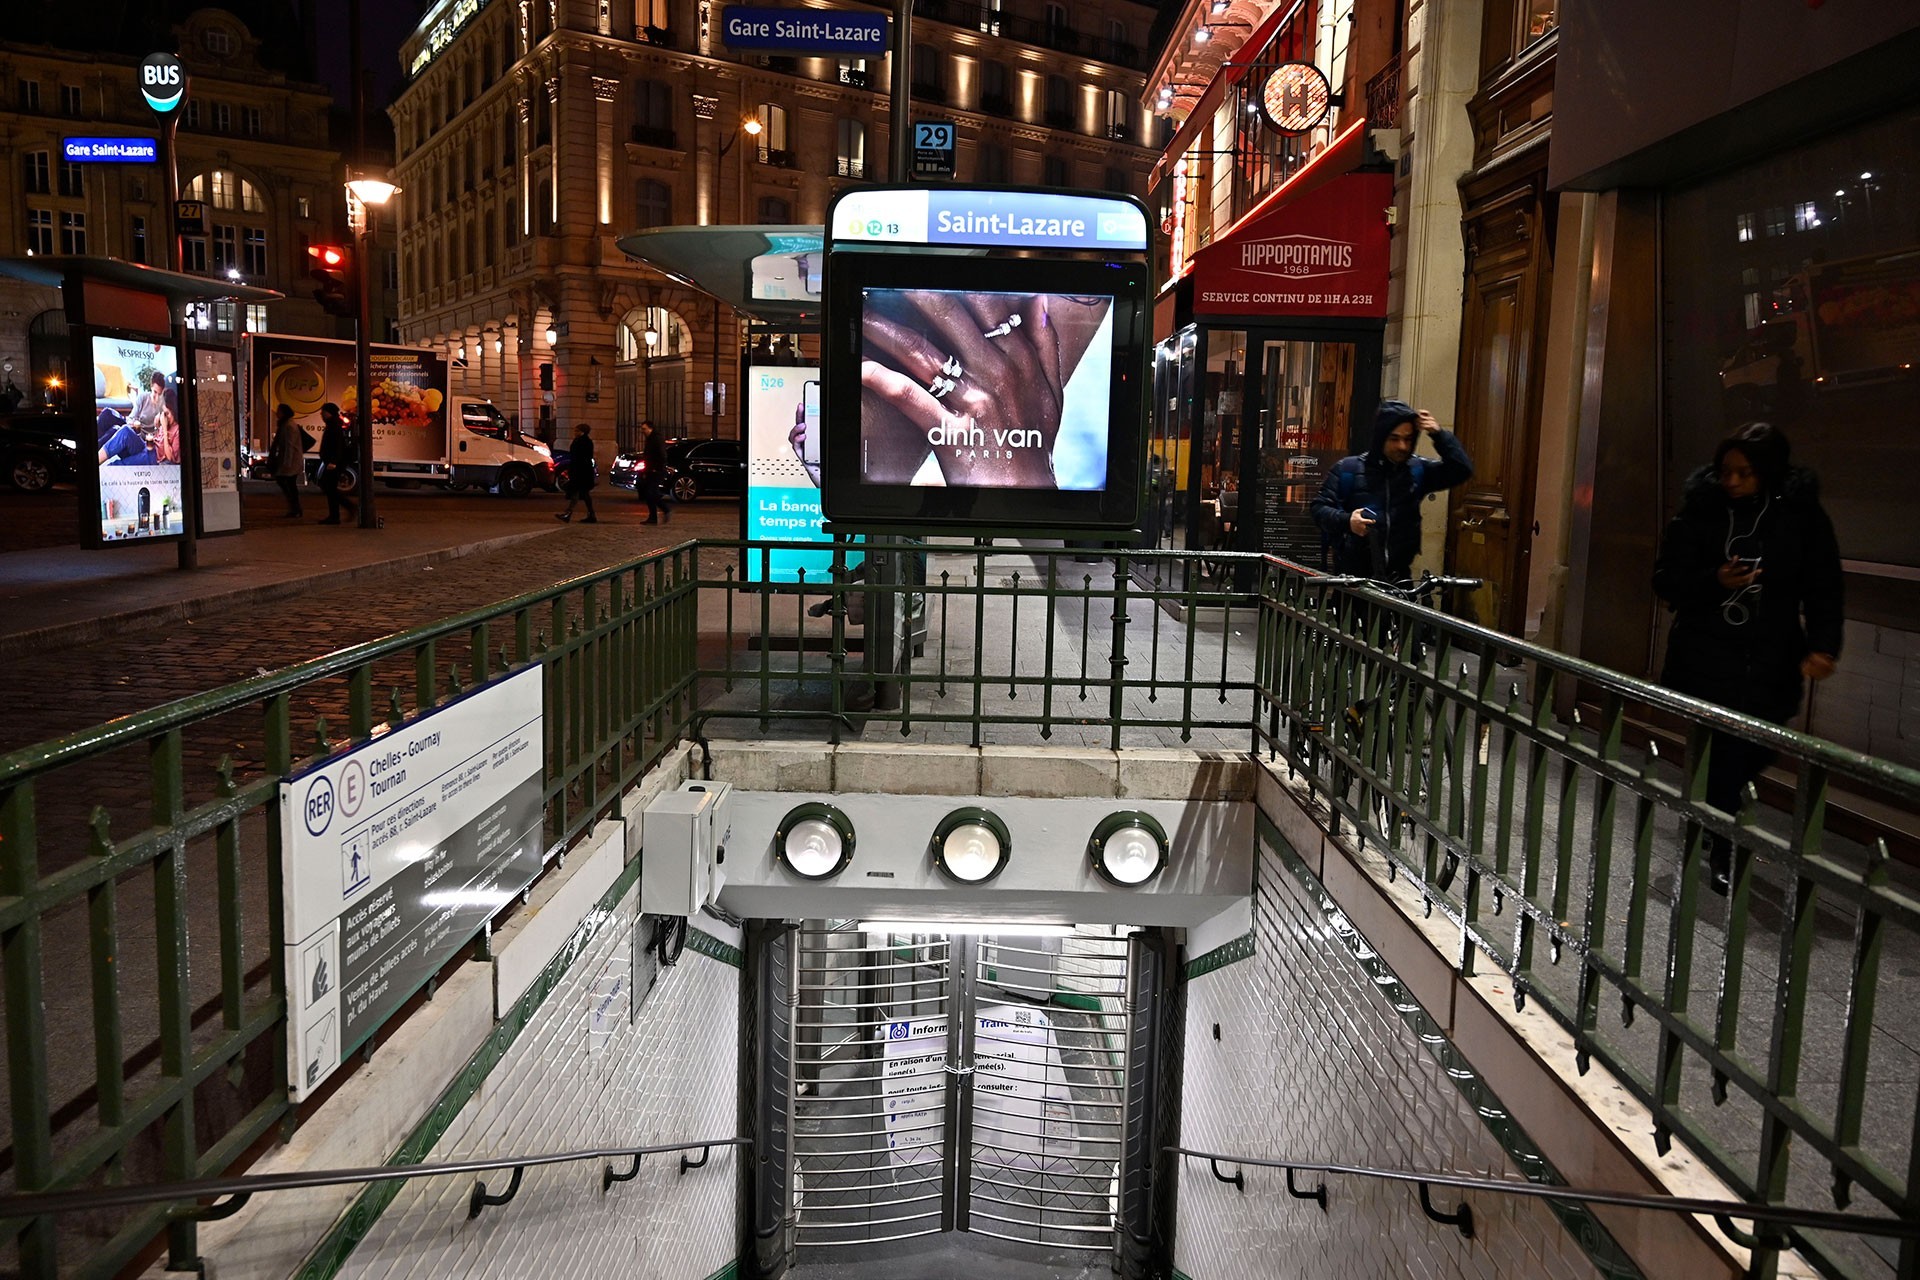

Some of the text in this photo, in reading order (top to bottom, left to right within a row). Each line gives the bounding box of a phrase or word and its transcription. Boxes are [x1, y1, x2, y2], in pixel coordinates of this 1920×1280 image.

[729, 18, 881, 42] Gare Saint-Lazare
[143, 65, 180, 85] BUS
[1282, 83, 1309, 118] H
[920, 126, 948, 147] 29
[66, 144, 154, 156] Gare Saint-Lazare
[181, 204, 198, 217] 27
[868, 222, 880, 234] 12
[887, 223, 899, 234] 13
[937, 210, 1086, 237] Saint-Lazare
[1241, 244, 1352, 268] HIPPOPOTAMUS
[1283, 266, 1310, 274] 1968
[1202, 292, 1250, 303] SERVICE
[1252, 293, 1304, 304] CONTINU
[1308, 294, 1322, 304] DE
[1352, 295, 1372, 304] 23H
[117, 346, 154, 360] NESPRESSO
[761, 376, 784, 389] N26
[927, 417, 1042, 448] dinh van
[955, 449, 1013, 459] PARIS
[760, 500, 778, 511] La
[759, 516, 824, 530] temps ré
[369, 751, 402, 777] Chelles
[408, 730, 441, 757] Gournay
[347, 774, 356, 804] E
[370, 768, 407, 798] Tournan
[308, 791, 331, 822] RER
[371, 796, 425, 836] Pour ces directions
[404, 802, 437, 829] Saint-Lazare
[346, 886, 394, 932] Accès réservé
[346, 903, 396, 948] aux voyageurs
[347, 915, 401, 966] munis de billets
[347, 938, 418, 1005] Vente de billets accès
[347, 980, 388, 1027] pl. du Havre
[913, 1024, 948, 1035] Inform
[900, 1058, 923, 1066] raison
